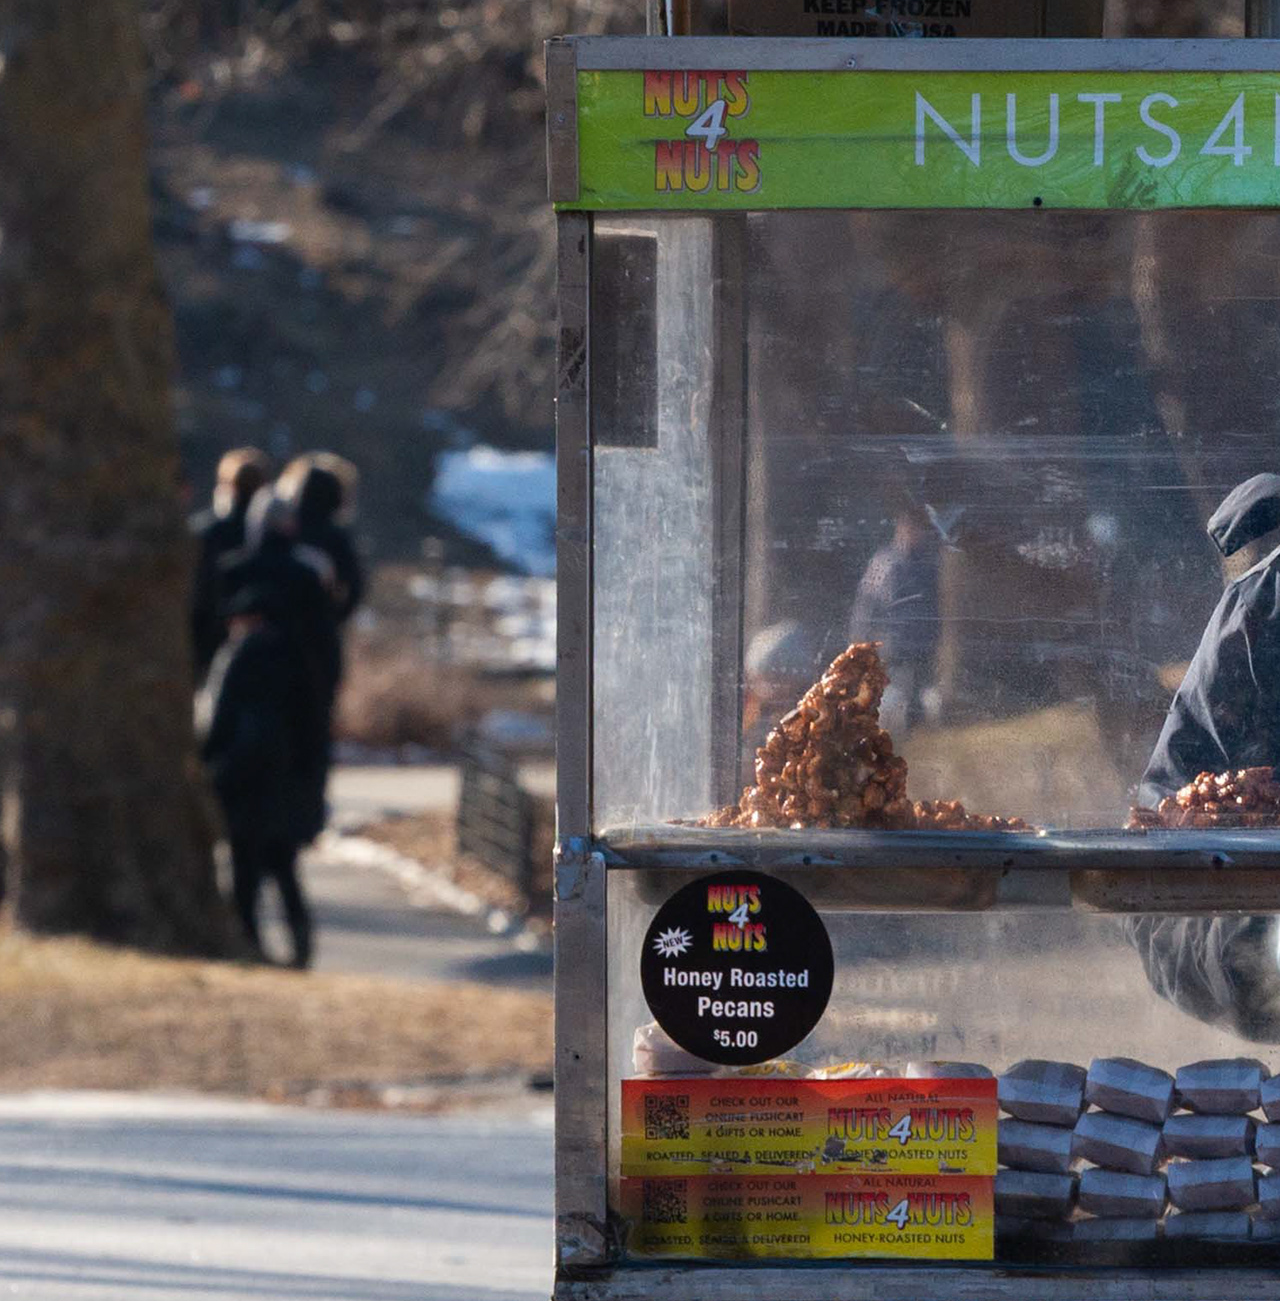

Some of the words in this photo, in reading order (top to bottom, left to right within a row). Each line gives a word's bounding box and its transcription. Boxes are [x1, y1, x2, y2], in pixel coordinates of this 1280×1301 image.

[817, 20, 882, 37] MADE
[643, 70, 751, 118] NUTS
[685, 99, 729, 153] 4
[655, 138, 762, 194] NUTS
[707, 884, 761, 913] NUTS
[728, 902, 749, 929] 4
[663, 936, 683, 948] NEW
[713, 923, 767, 952] NUTS
[663, 967, 723, 990] Honey
[731, 968, 809, 988] Roasted
[698, 996, 775, 1018] Pecans
[713, 1029, 758, 1048] $5.00
[710, 1097, 746, 1108] CHECK
[749, 1096, 771, 1107] OUT
[775, 1096, 799, 1107] OUR
[865, 1093, 884, 1103] ALL
[888, 1093, 940, 1104] NATURAL
[705, 1112, 747, 1123] ONLINE
[750, 1111, 804, 1123] PUSHCART
[715, 1127, 746, 1139] GIFTS
[749, 1128, 765, 1138] OR
[827, 1107, 977, 1145] NUTS4NUTS
[938, 1149, 969, 1160] NUTS
[747, 1181, 769, 1191] OUT
[773, 1181, 797, 1191] OUR
[863, 1178, 881, 1187] ALL
[885, 1177, 937, 1188] NATURAL
[748, 1196, 803, 1206] PUSHCART
[747, 1212, 762, 1221] OR
[825, 1191, 972, 1231] NUTS4NUTS
[834, 1233, 932, 1244] HONEY-ROASTED
[935, 1233, 966, 1244] NUTS
